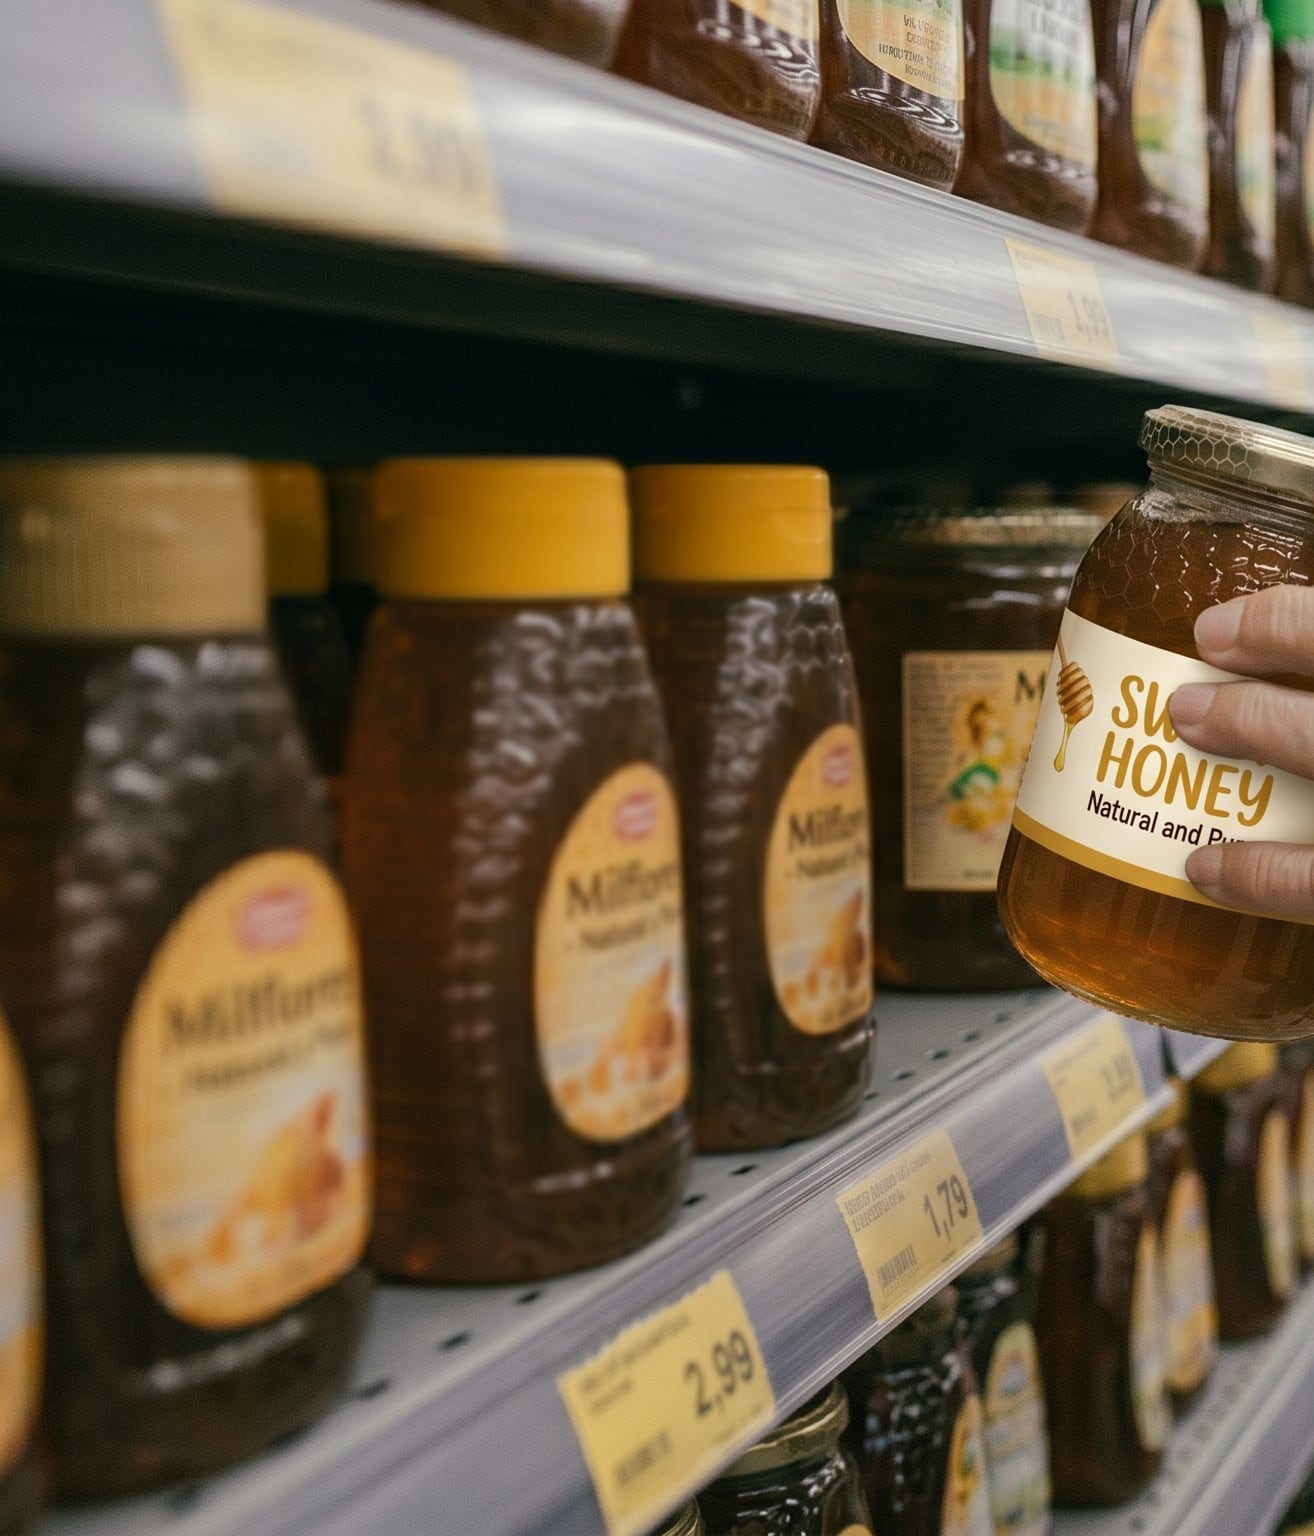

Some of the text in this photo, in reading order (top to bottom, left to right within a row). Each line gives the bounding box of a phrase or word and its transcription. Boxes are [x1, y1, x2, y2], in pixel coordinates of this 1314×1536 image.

[1087, 790, 1159, 833] Natural
[1161, 824, 1203, 846] and
[1096, 731, 1274, 827] HONEY
[923, 1173, 968, 1243] 1,79
[684, 1329, 754, 1418] 2,99
